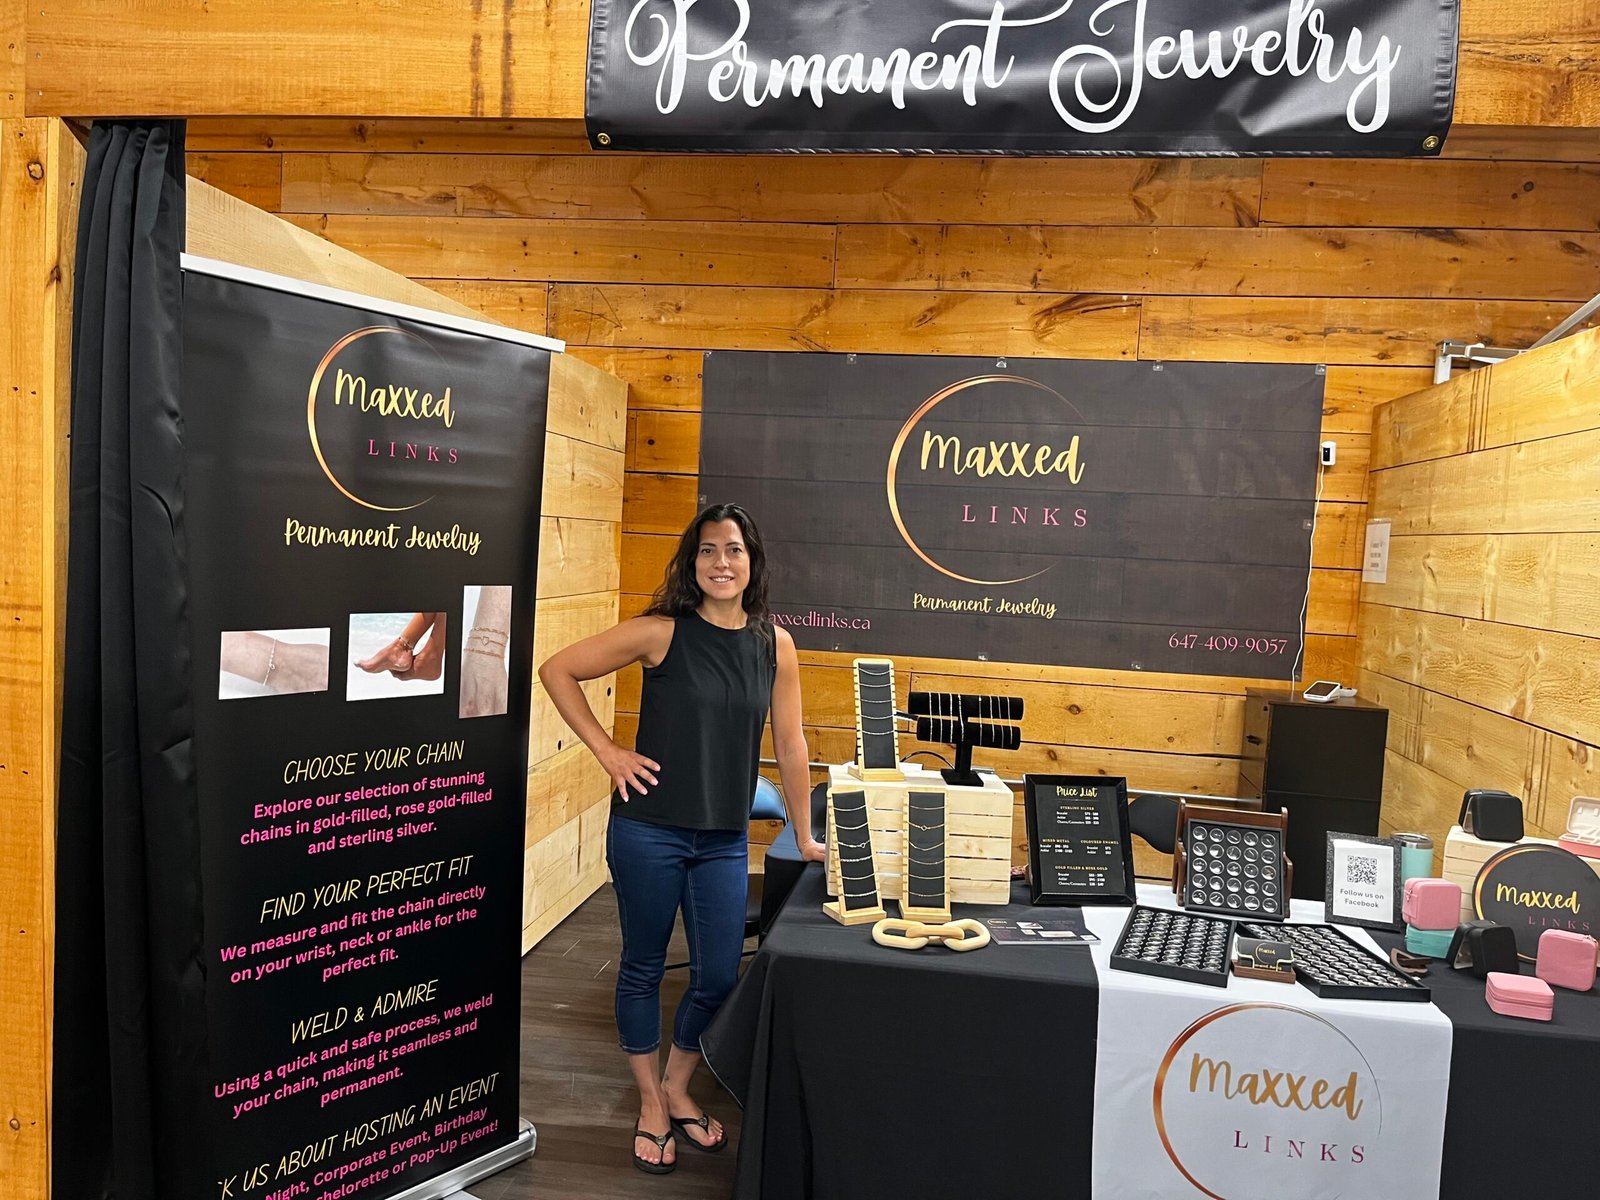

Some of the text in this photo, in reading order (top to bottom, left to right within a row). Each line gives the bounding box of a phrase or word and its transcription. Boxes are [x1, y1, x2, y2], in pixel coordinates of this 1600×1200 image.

[624, 0, 1401, 133] Permanent Jewelry
[334, 369, 455, 428] Maxxed
[368, 439, 458, 464] LINKS
[920, 430, 1085, 485] Maxxed
[284, 517, 482, 555] Permanent Jewelry
[962, 504, 1087, 528] LINKS
[768, 611, 871, 630] axxedlinks.ca
[913, 593, 1057, 619] Permanent Jewelry
[1168, 632, 1288, 656] 647-409-9057
[284, 740, 464, 784] CHOOSE YOUR CHAIN
[254, 772, 484, 819] Explore our selection of stunning
[1056, 785, 1098, 798] Price List
[240, 790, 492, 845] chains in gold-filled, rose gold-filled
[308, 820, 437, 854] and sterling silver.
[261, 855, 473, 923] FIND YOUR PERFECT FIT
[1340, 888, 1363, 897] Follow
[1344, 898, 1380, 908] Facebook
[1496, 883, 1581, 914] Maxxed
[221, 887, 484, 961] We measure and fit the chain directly
[1528, 915, 1590, 930] LINKS
[231, 909, 477, 983] on your wrist, neck or ankle for the
[323, 947, 398, 980] perfect fit.
[293, 979, 438, 1043] WELD & ADMIRE
[215, 993, 493, 1098] Using a quick and safe process, we weld
[234, 1020, 477, 1118] your chain, making it seamless and
[321, 1067, 404, 1107] permanent.
[1189, 1052, 1363, 1120] Maxxed
[244, 1164, 270, 1191] US
[275, 1135, 338, 1179] ABOUT
[343, 1105, 416, 1151] HOSTING
[420, 1094, 443, 1120] AN
[449, 1073, 499, 1109] EVENT
[314, 1151, 386, 1185] Corporate
[390, 1130, 430, 1155] Event,
[434, 1107, 488, 1136] Birthday
[392, 1160, 406, 1174] or
[410, 1140, 457, 1167] Pop-Up
[461, 1120, 498, 1144] Event!
[1233, 1130, 1365, 1164] LINKS
